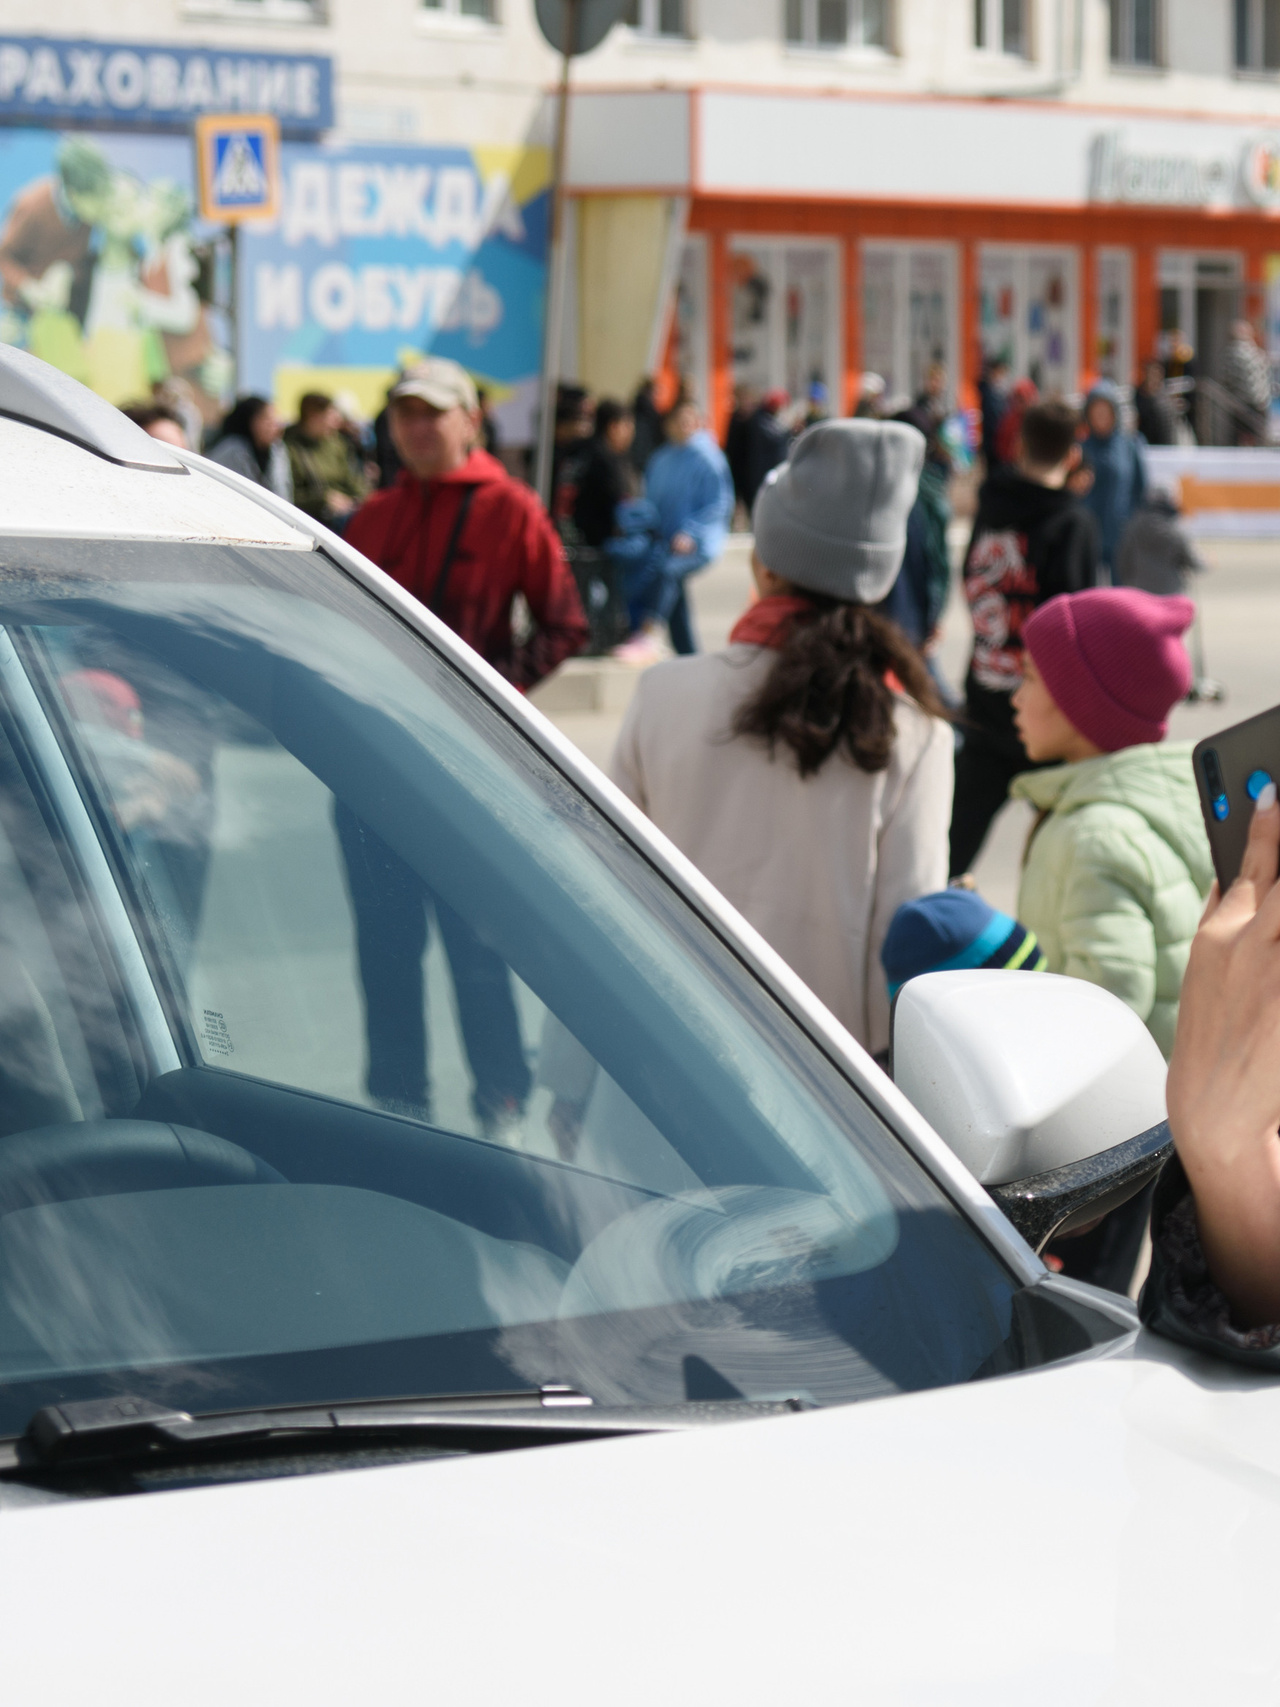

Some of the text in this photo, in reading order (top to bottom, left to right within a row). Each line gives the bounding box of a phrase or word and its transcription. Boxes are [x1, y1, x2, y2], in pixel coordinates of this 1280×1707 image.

[256, 163, 523, 246] ДЕЖДА
[255, 263, 502, 332] И ОБУВЬ
